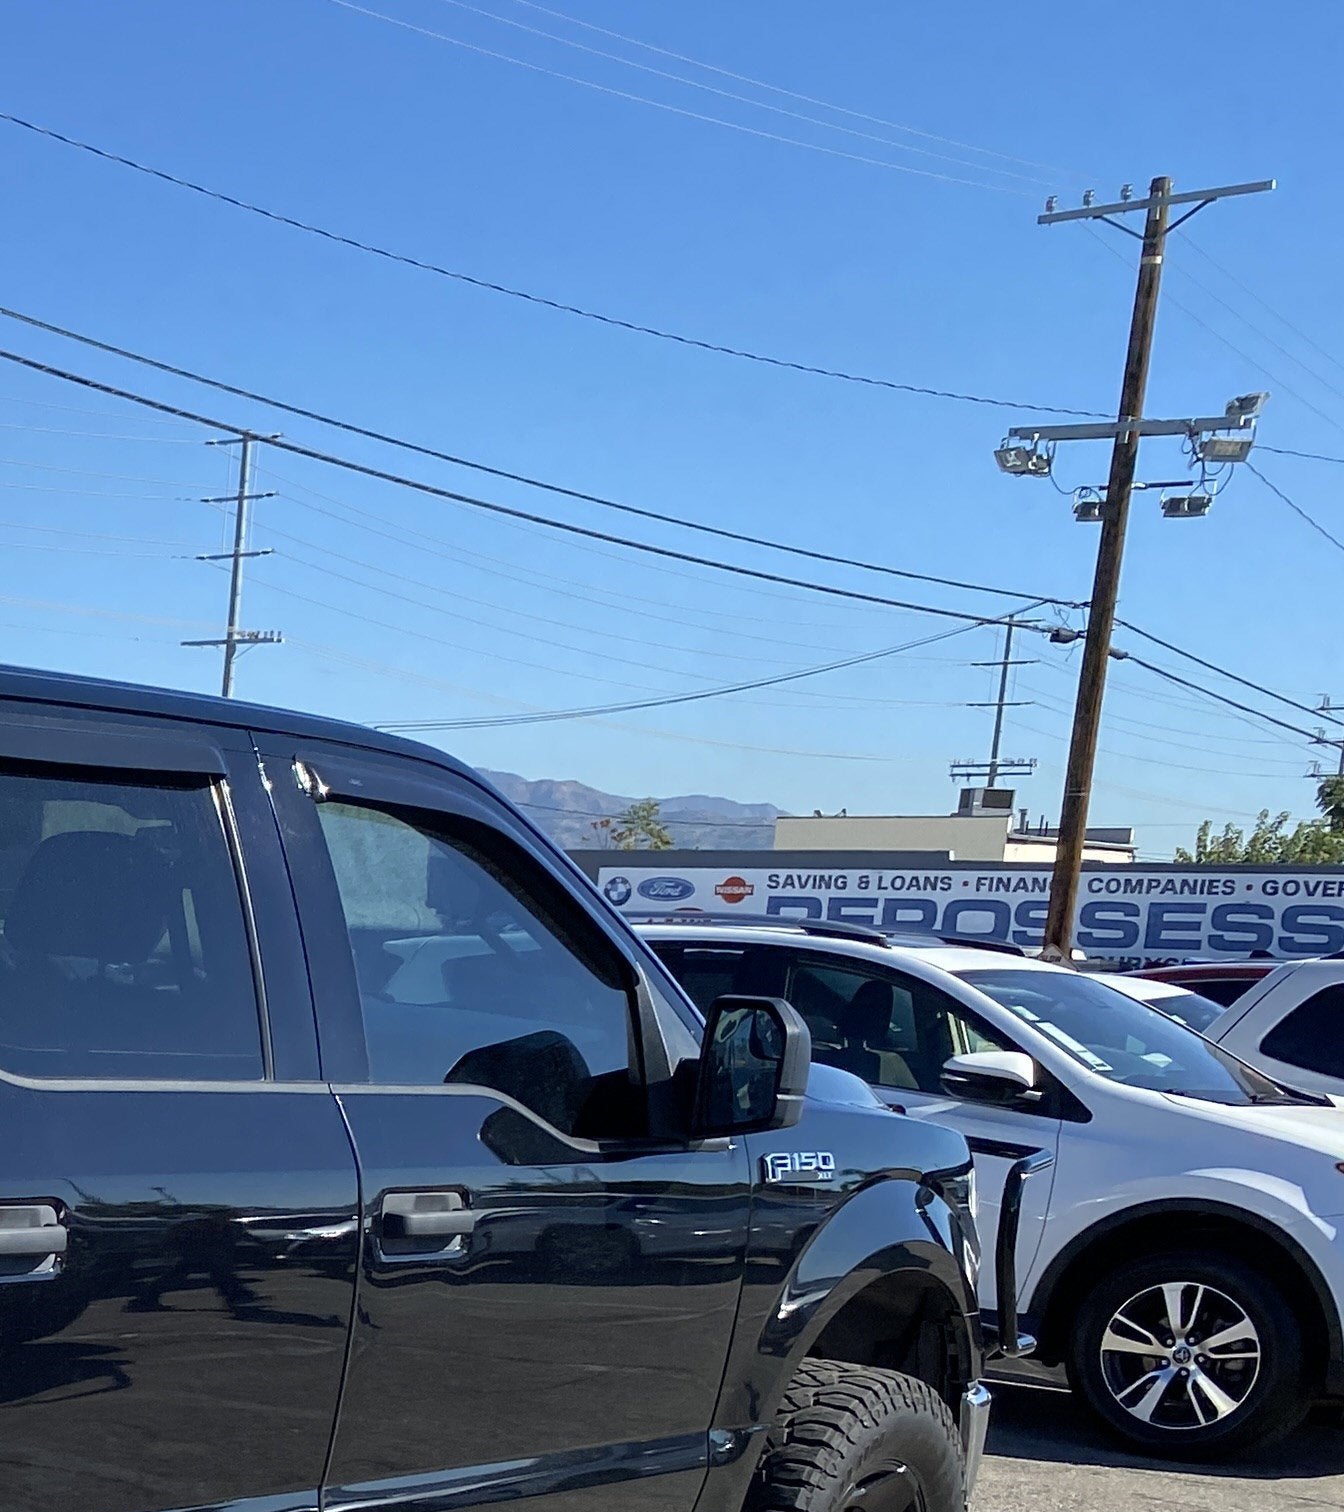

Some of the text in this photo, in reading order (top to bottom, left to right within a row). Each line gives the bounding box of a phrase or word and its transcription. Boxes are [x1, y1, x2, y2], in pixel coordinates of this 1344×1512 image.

[649, 881, 683, 896] Ford
[715, 886, 753, 895] NISSAN
[766, 874, 848, 891] SAVING
[857, 874, 870, 890] &
[877, 875, 953, 892] LOANS
[975, 876, 1052, 893] FINAN
[1087, 877, 1236, 896] COMPANIES
